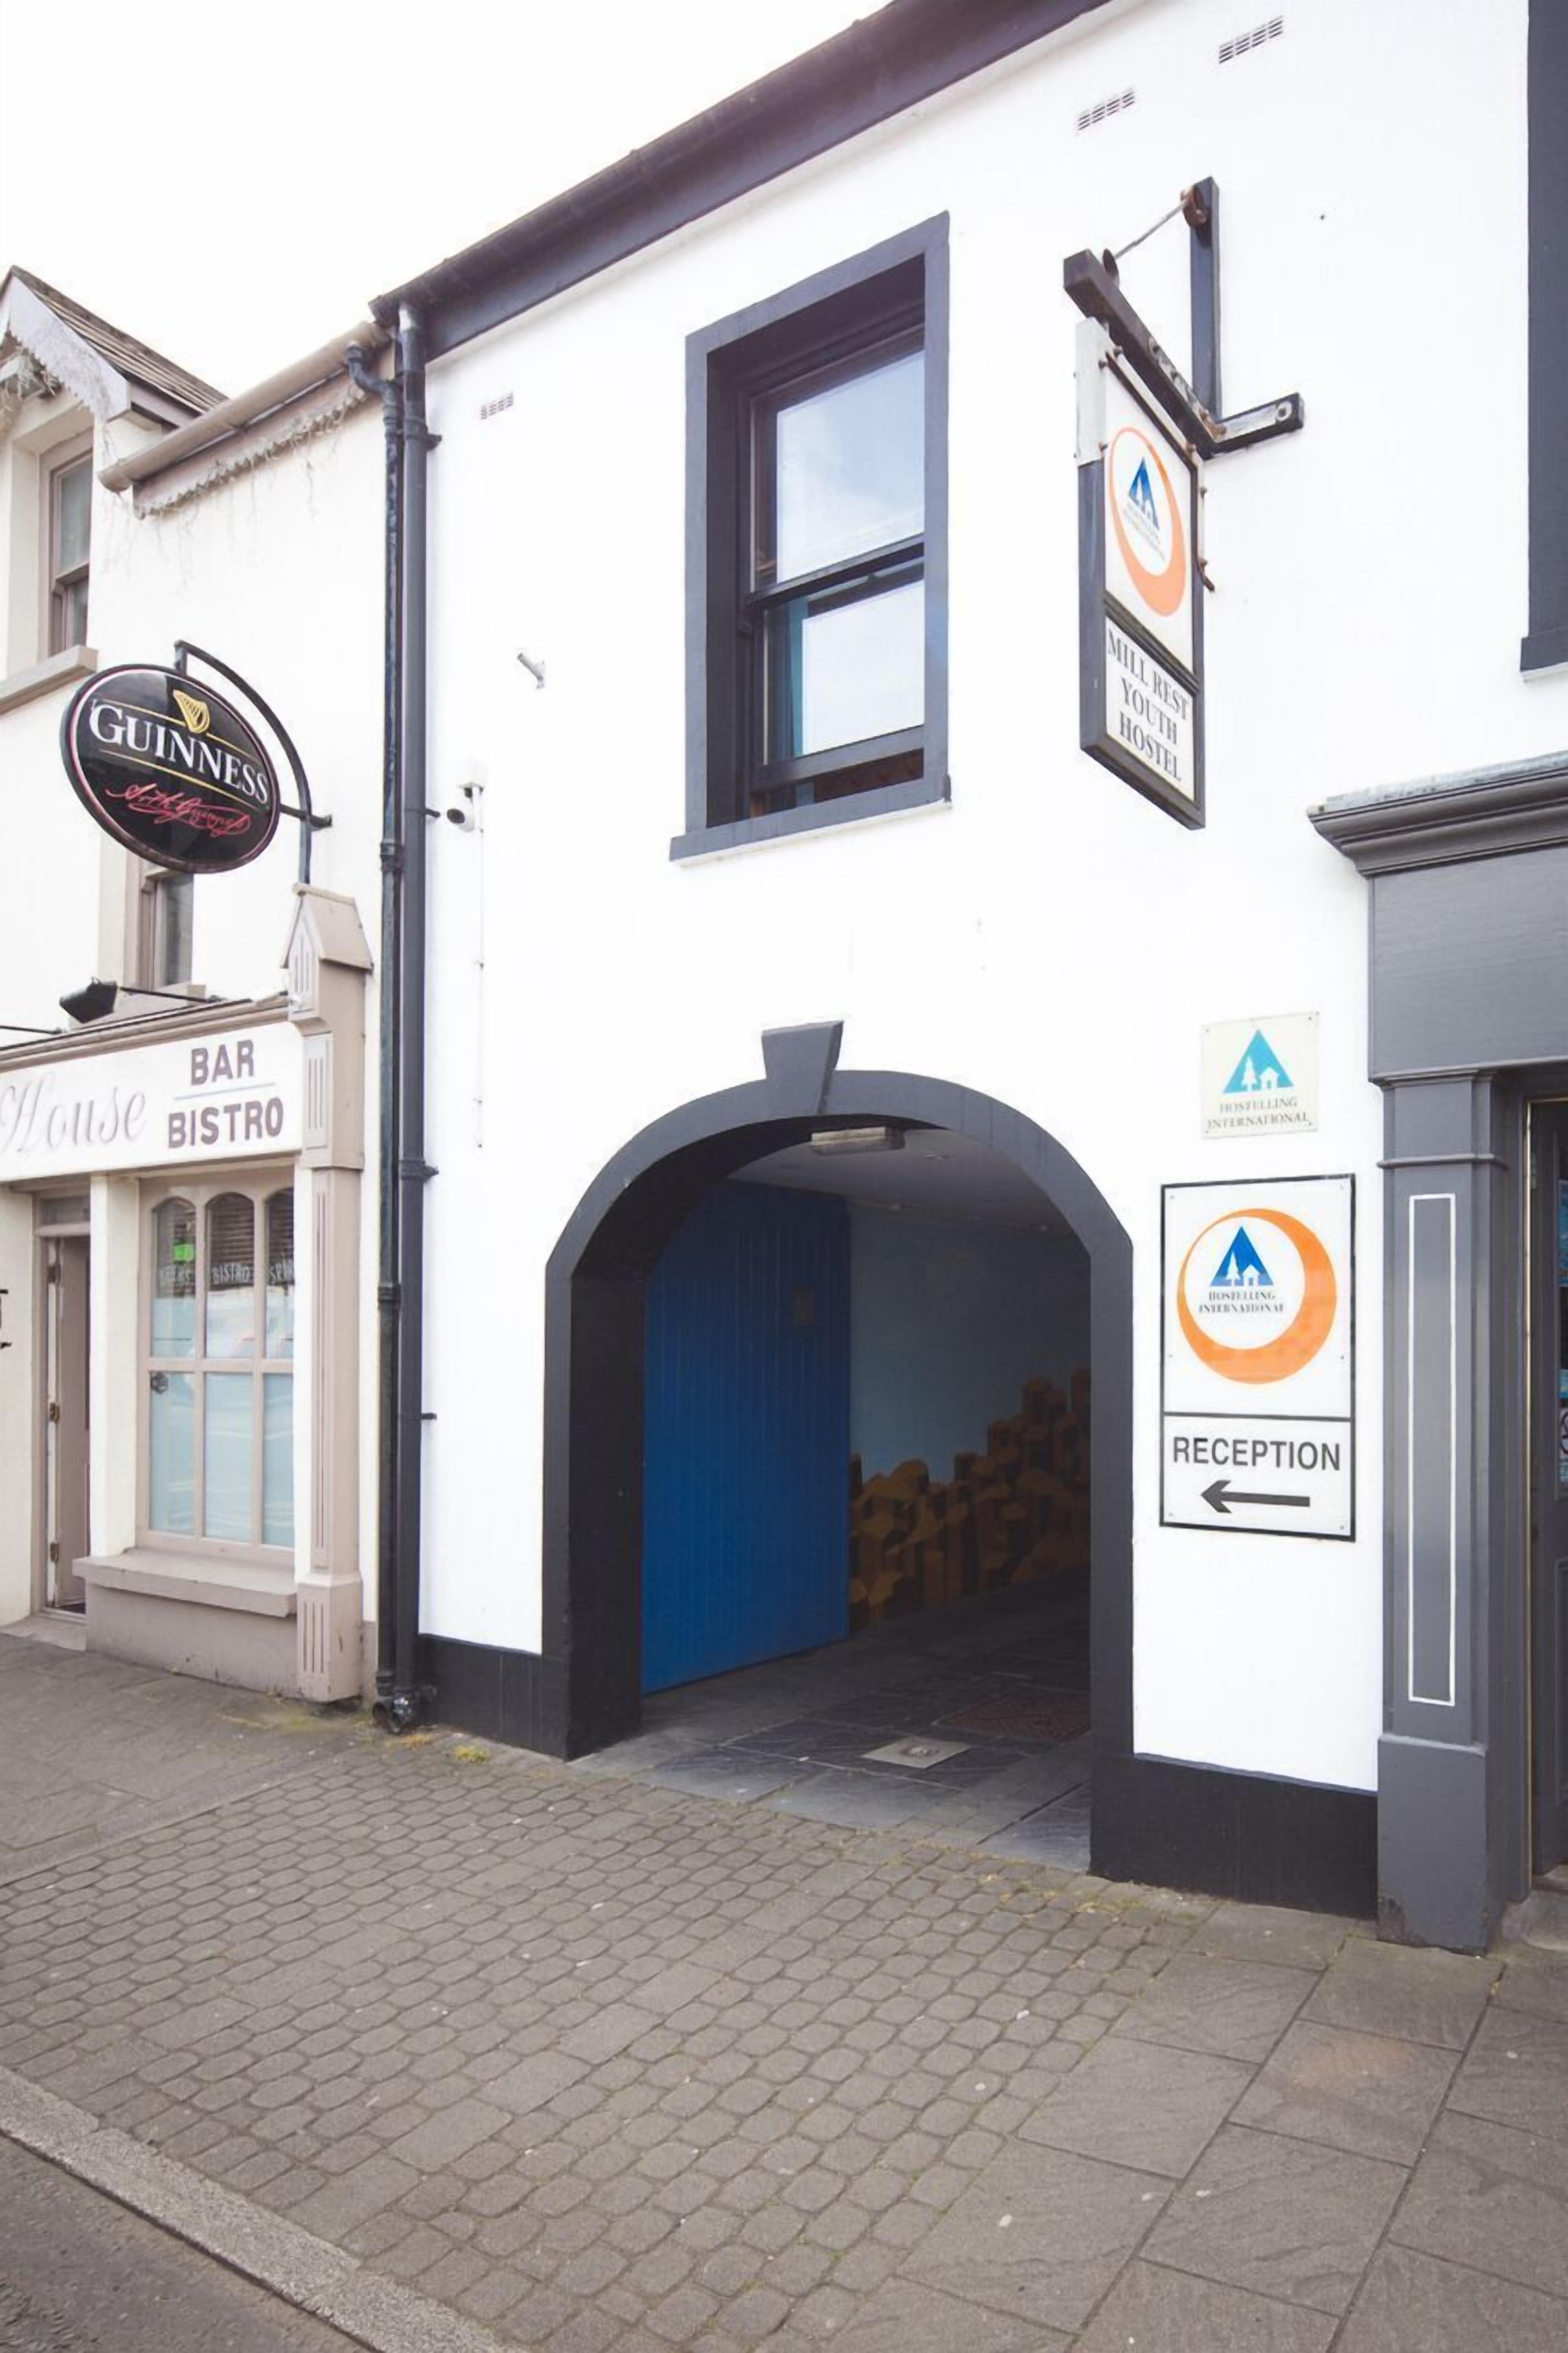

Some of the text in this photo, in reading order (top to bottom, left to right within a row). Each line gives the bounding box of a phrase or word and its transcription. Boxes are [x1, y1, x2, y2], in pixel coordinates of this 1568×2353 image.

[1108, 627, 1188, 720] MILL REST
[1121, 676, 1177, 745] YOUTH
[89, 704, 268, 804] GUINNESS
[1120, 711, 1182, 782] HOSTEL
[191, 1039, 255, 1086] BAR
[0, 1071, 146, 1153] House
[168, 1097, 284, 1149] BISTRO
[1207, 1112, 1307, 1129] INTERNATIONAL
[1173, 1436, 1340, 1471] RECEPTION
